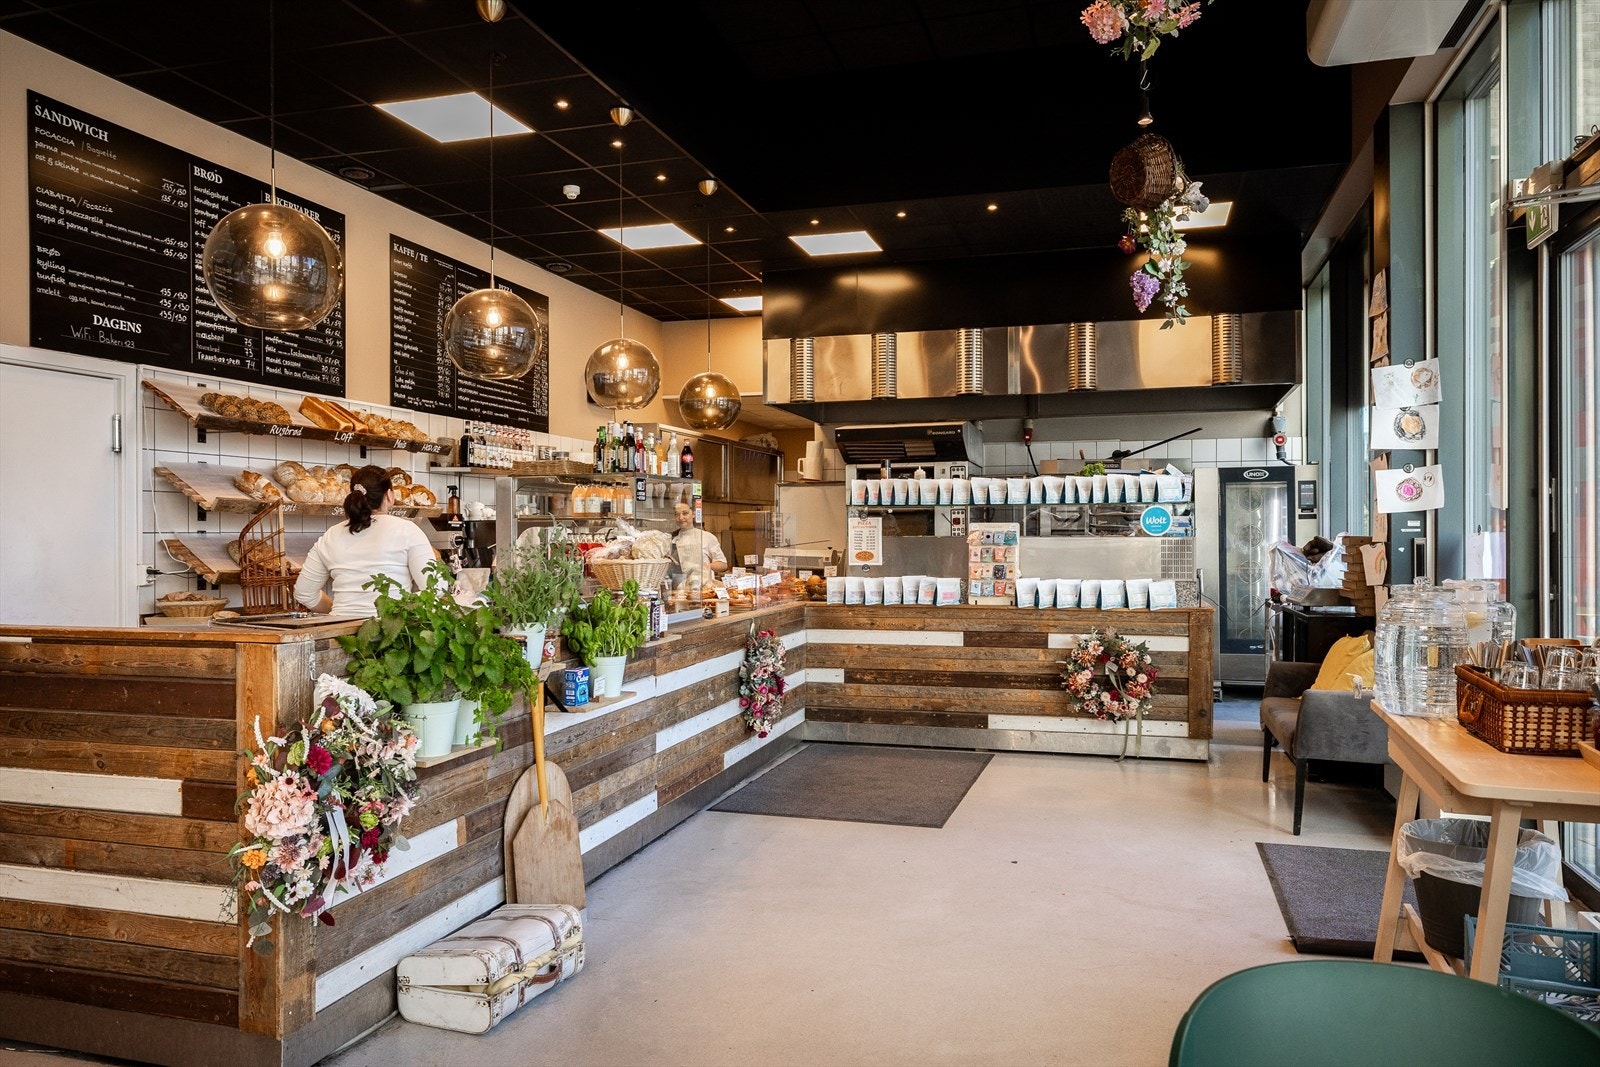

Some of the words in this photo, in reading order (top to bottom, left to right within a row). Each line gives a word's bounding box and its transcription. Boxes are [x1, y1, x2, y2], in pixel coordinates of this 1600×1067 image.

[34, 104, 109, 142] SANDWICH
[34, 126, 75, 147] FOCACCIA
[193, 165, 223, 184] BRØD
[36, 186, 76, 204] CIABATTA
[264, 192, 321, 222] BKERVARER
[393, 242, 415, 258] KAFFE
[419, 252, 428, 263] TE
[93, 314, 142, 334] DAGENS
[334, 431, 355, 443] Loff
[1145, 515, 1168, 525] Wolt
